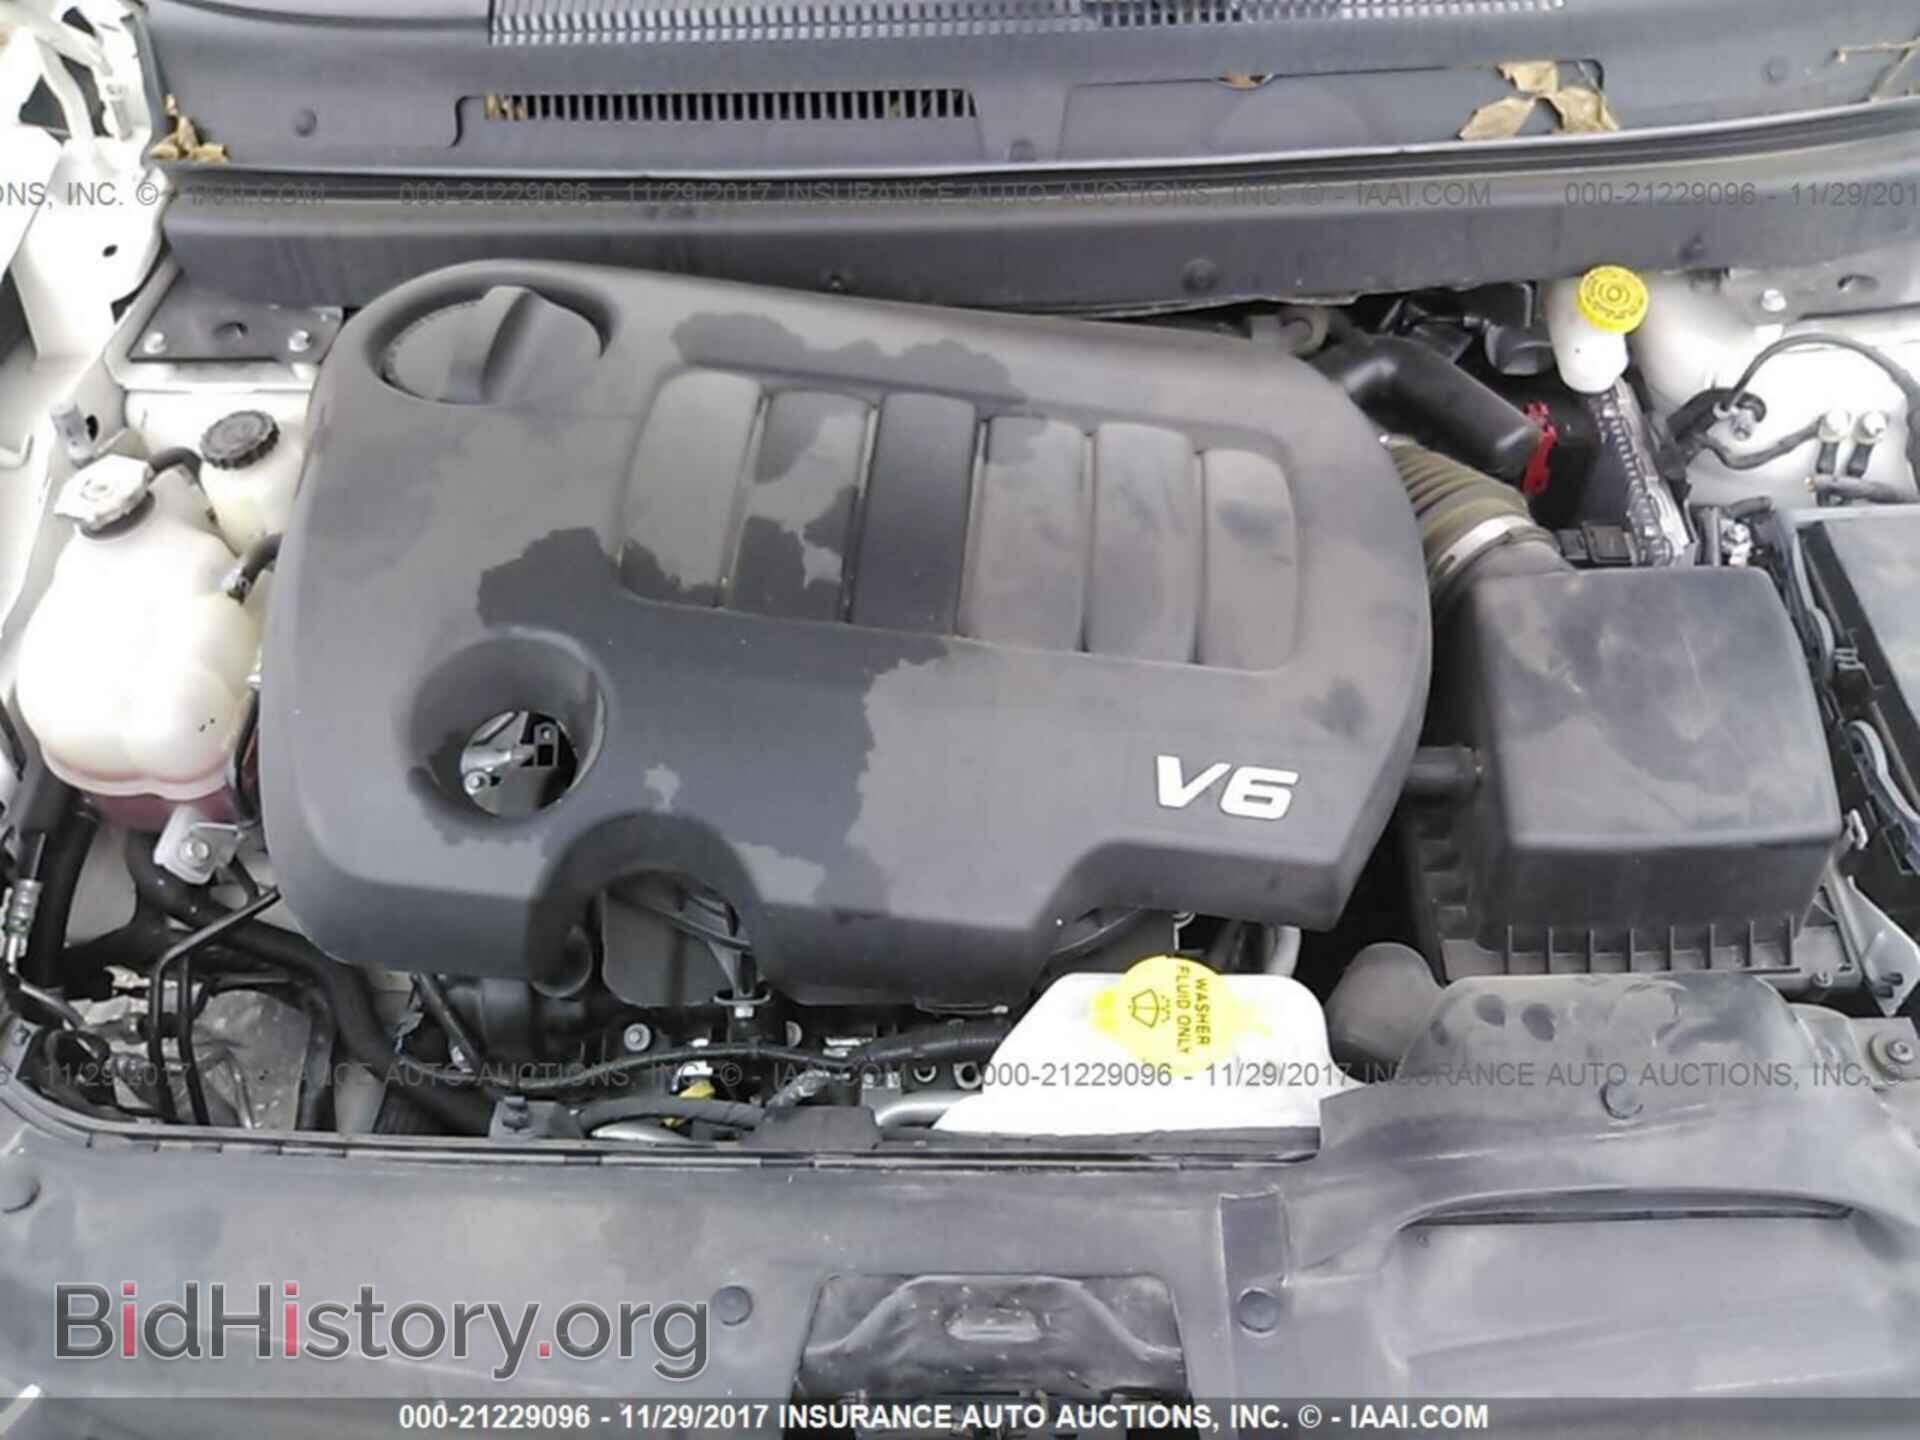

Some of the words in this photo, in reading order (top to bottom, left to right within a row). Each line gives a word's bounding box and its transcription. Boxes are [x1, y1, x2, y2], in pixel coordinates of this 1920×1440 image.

[1156, 754, 1299, 820] V6
[1176, 965, 1190, 1011] FLUID
[1194, 978, 1211, 1045] WASHER
[1176, 1014, 1192, 1054] ONLY
